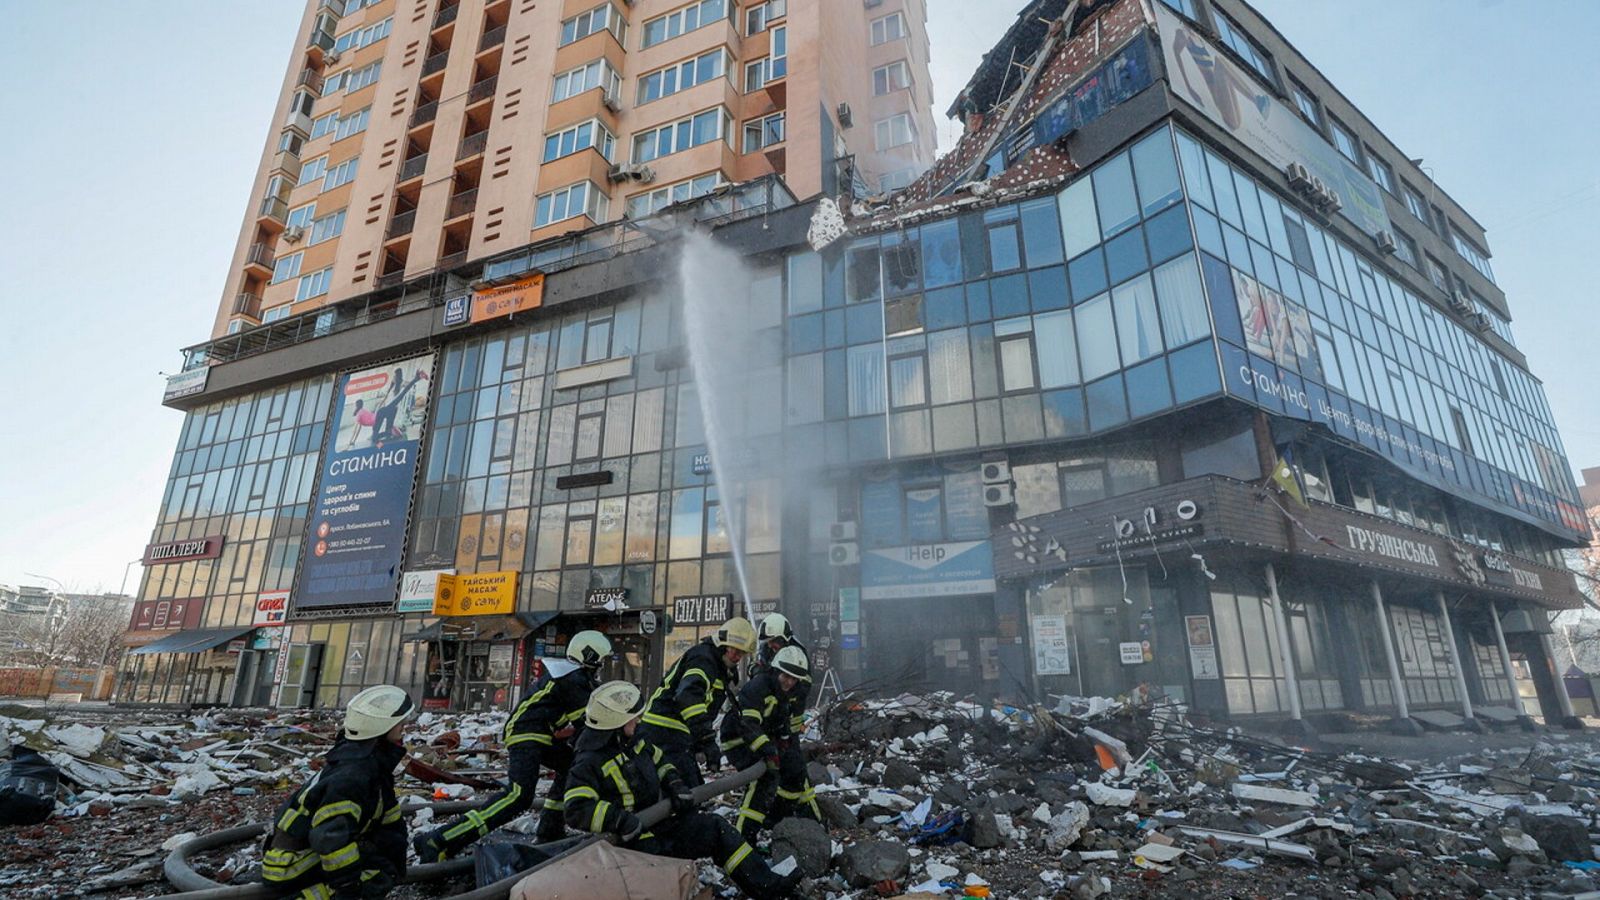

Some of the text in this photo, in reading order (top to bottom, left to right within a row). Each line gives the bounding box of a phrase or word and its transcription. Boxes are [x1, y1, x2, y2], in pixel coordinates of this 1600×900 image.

[1318, 398, 1350, 428] Центр
[326, 484, 347, 494] Центр
[354, 491, 377, 500] спини
[330, 503, 360, 516] суглобів
[150, 540, 207, 560] ШПАЛЕРИ
[1346, 525, 1440, 567] ГРУЗИНСЬКА
[463, 576, 506, 587] ТАЙСЬКИЙ
[1511, 566, 1544, 590] КУХНЯ
[468, 586, 498, 594] МАСАЖ
[675, 597, 728, 624] COZY BAR
